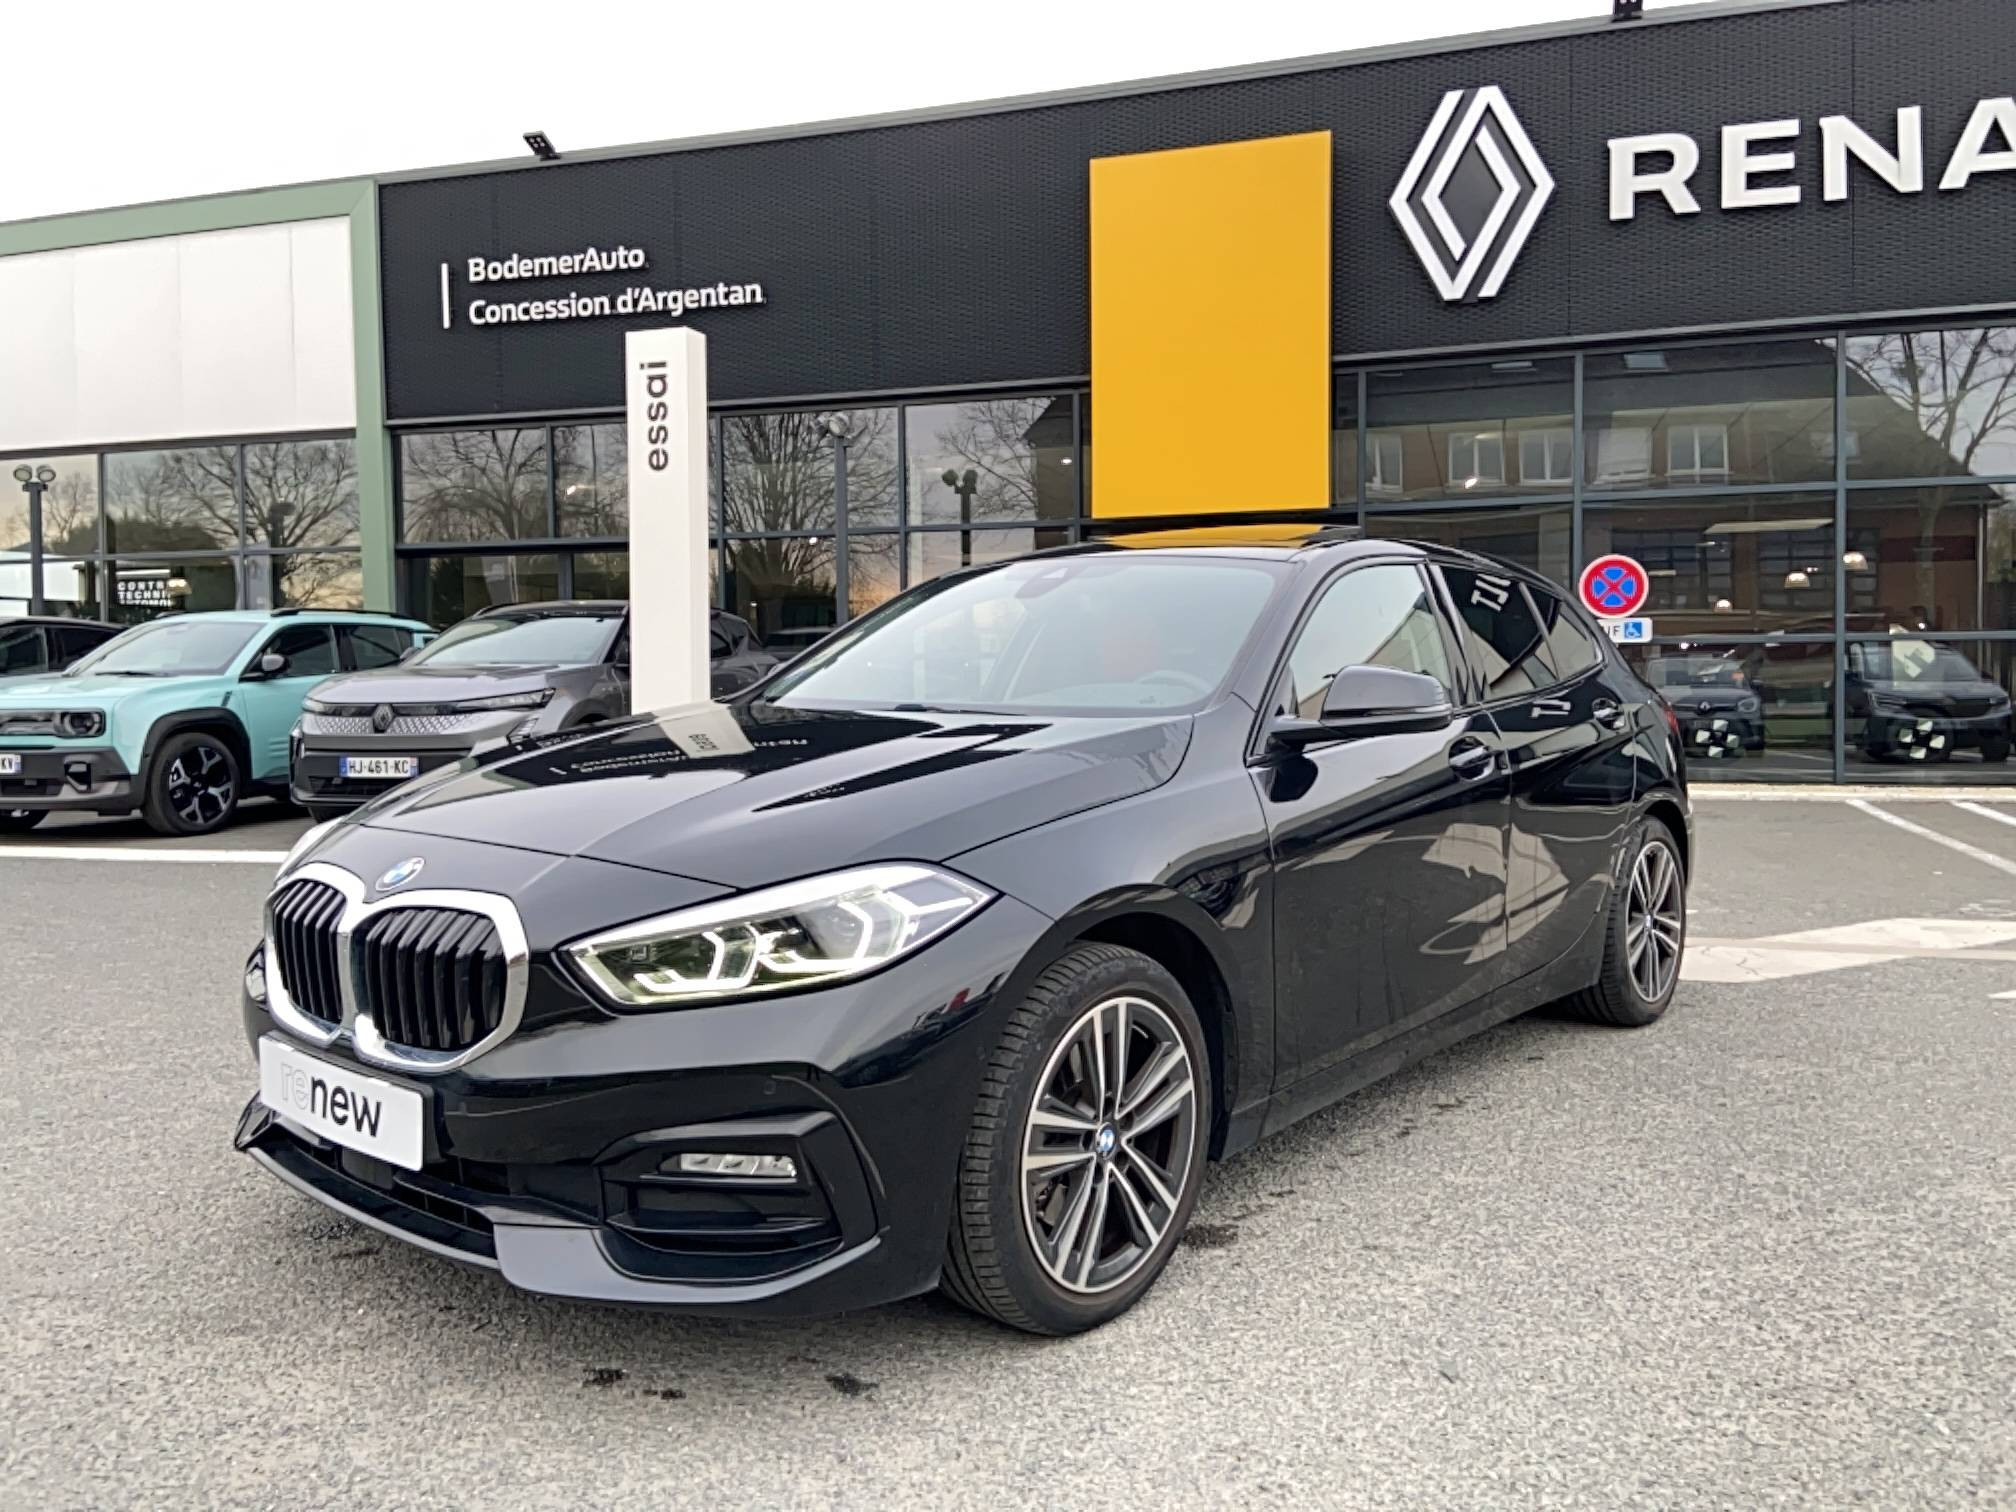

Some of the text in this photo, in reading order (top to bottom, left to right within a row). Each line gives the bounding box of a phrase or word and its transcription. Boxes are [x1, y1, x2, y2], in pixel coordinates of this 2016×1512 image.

[1607, 96, 2016, 222] RENA
[467, 245, 646, 283] BodemerAuto
[468, 281, 763, 326] Concession d'Argentan
[639, 360, 669, 472] essai
[348, 759, 409, 774] HJ-461-KC
